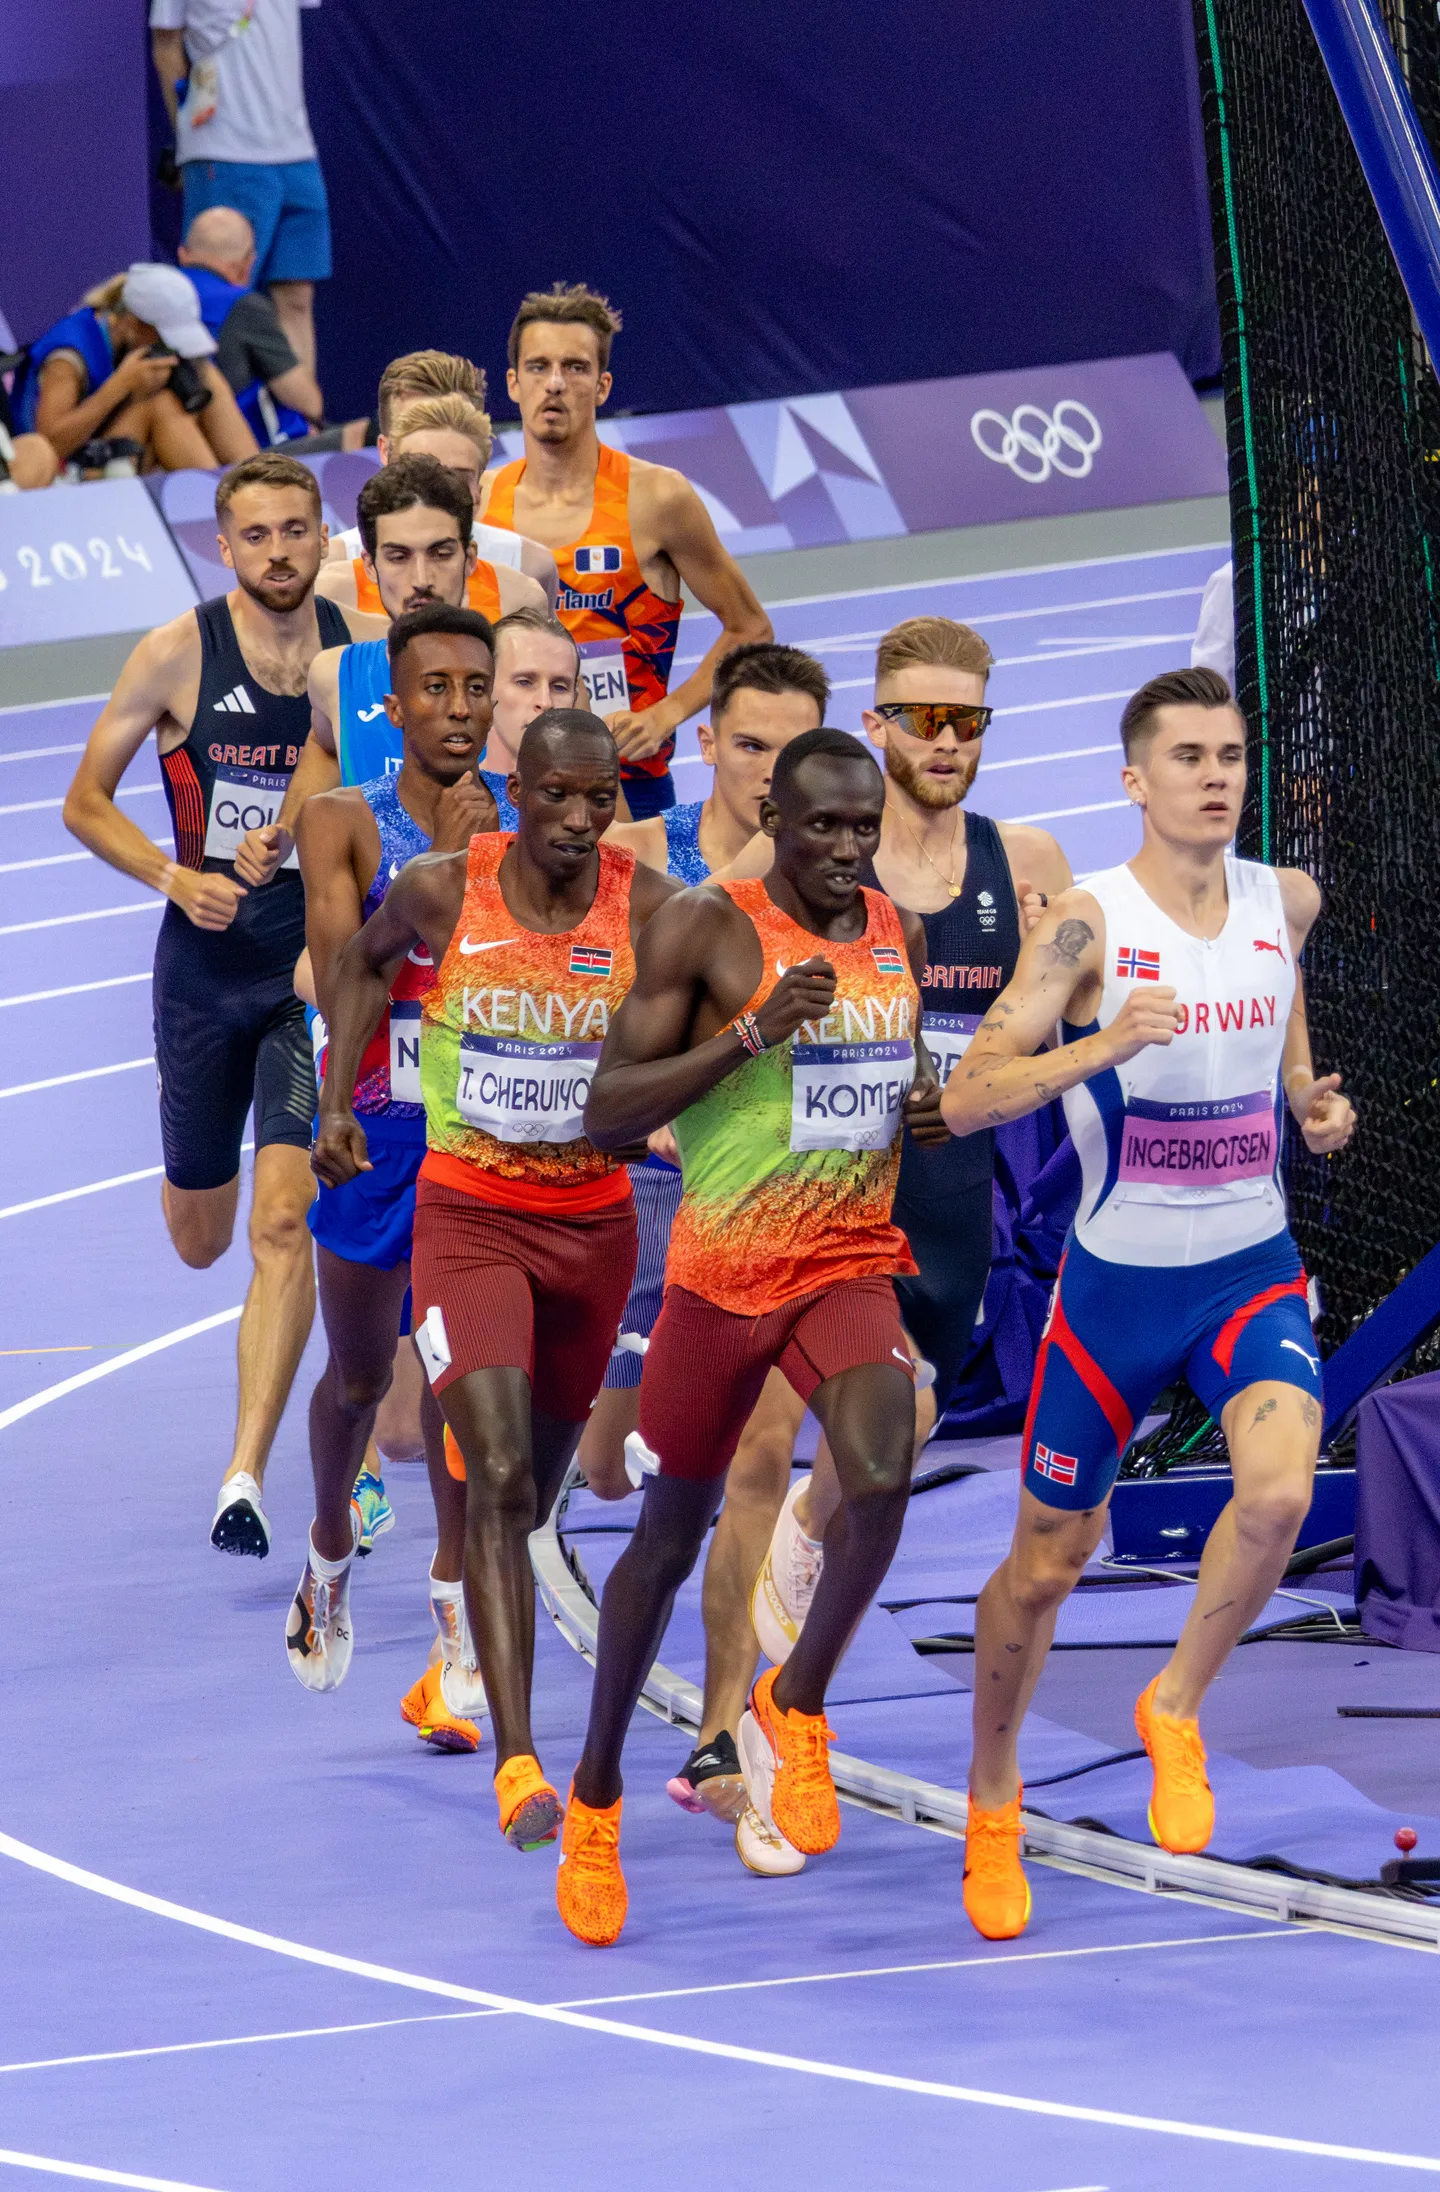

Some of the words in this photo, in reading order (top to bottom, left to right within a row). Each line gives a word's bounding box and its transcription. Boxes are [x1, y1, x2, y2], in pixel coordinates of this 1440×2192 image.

[17, 535, 153, 587] 2024
[208, 743, 280, 766] GREAT
[252, 774, 286, 787] PARIS
[463, 986, 608, 1037] KENYA
[929, 1016, 965, 1029] 2024
[496, 1042, 535, 1056] PARIS
[539, 1046, 573, 1056] 2024
[832, 1049, 866, 1059] PARIS
[868, 1046, 898, 1057] 2024
[462, 1067, 475, 1101] T.
[1170, 1107, 1208, 1116] PARIS
[1212, 1103, 1244, 1115] 2024
[1126, 1130, 1271, 1171] INGEBRIGTSEN
